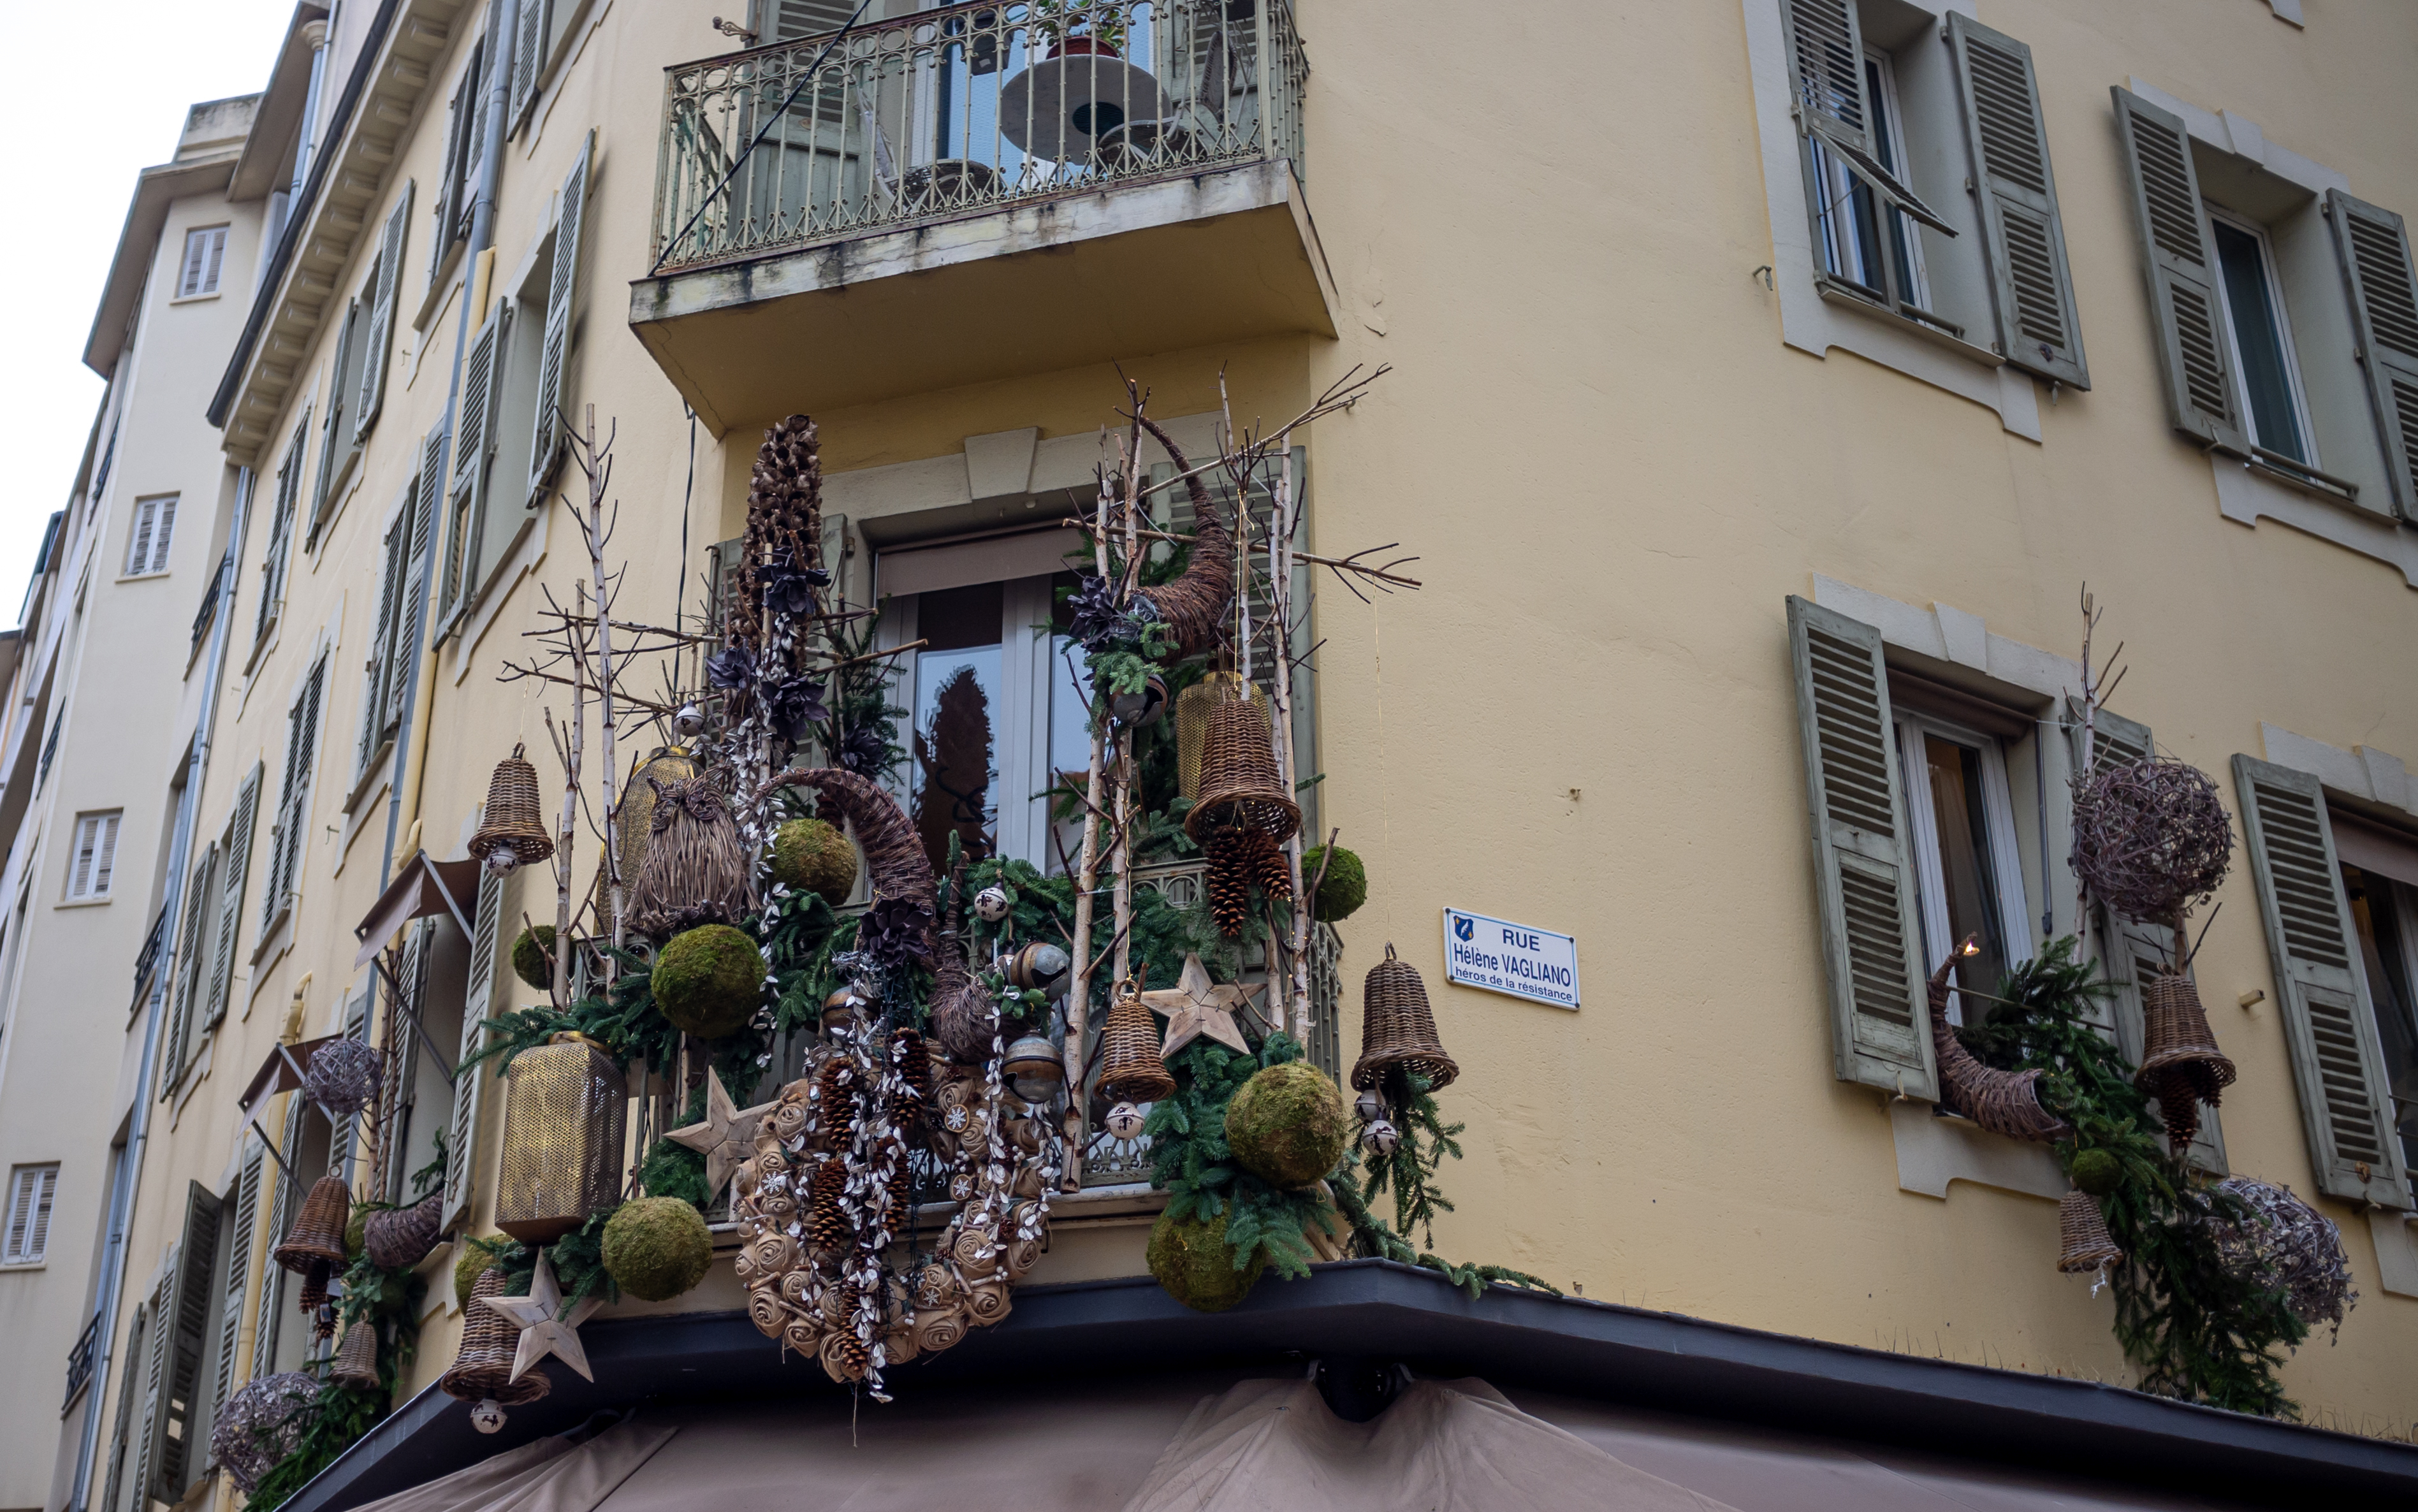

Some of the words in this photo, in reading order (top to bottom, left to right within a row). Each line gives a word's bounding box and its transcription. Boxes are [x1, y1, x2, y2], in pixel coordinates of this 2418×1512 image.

[1503, 929, 1540, 952] RUE
[1454, 943, 1498, 971] Hélène
[1501, 954, 1571, 987] VAGLIANO
[1455, 966, 1486, 982] héros
[1490, 975, 1503, 985] de
[1506, 977, 1515, 989] la
[1519, 982, 1573, 1001] résistance
